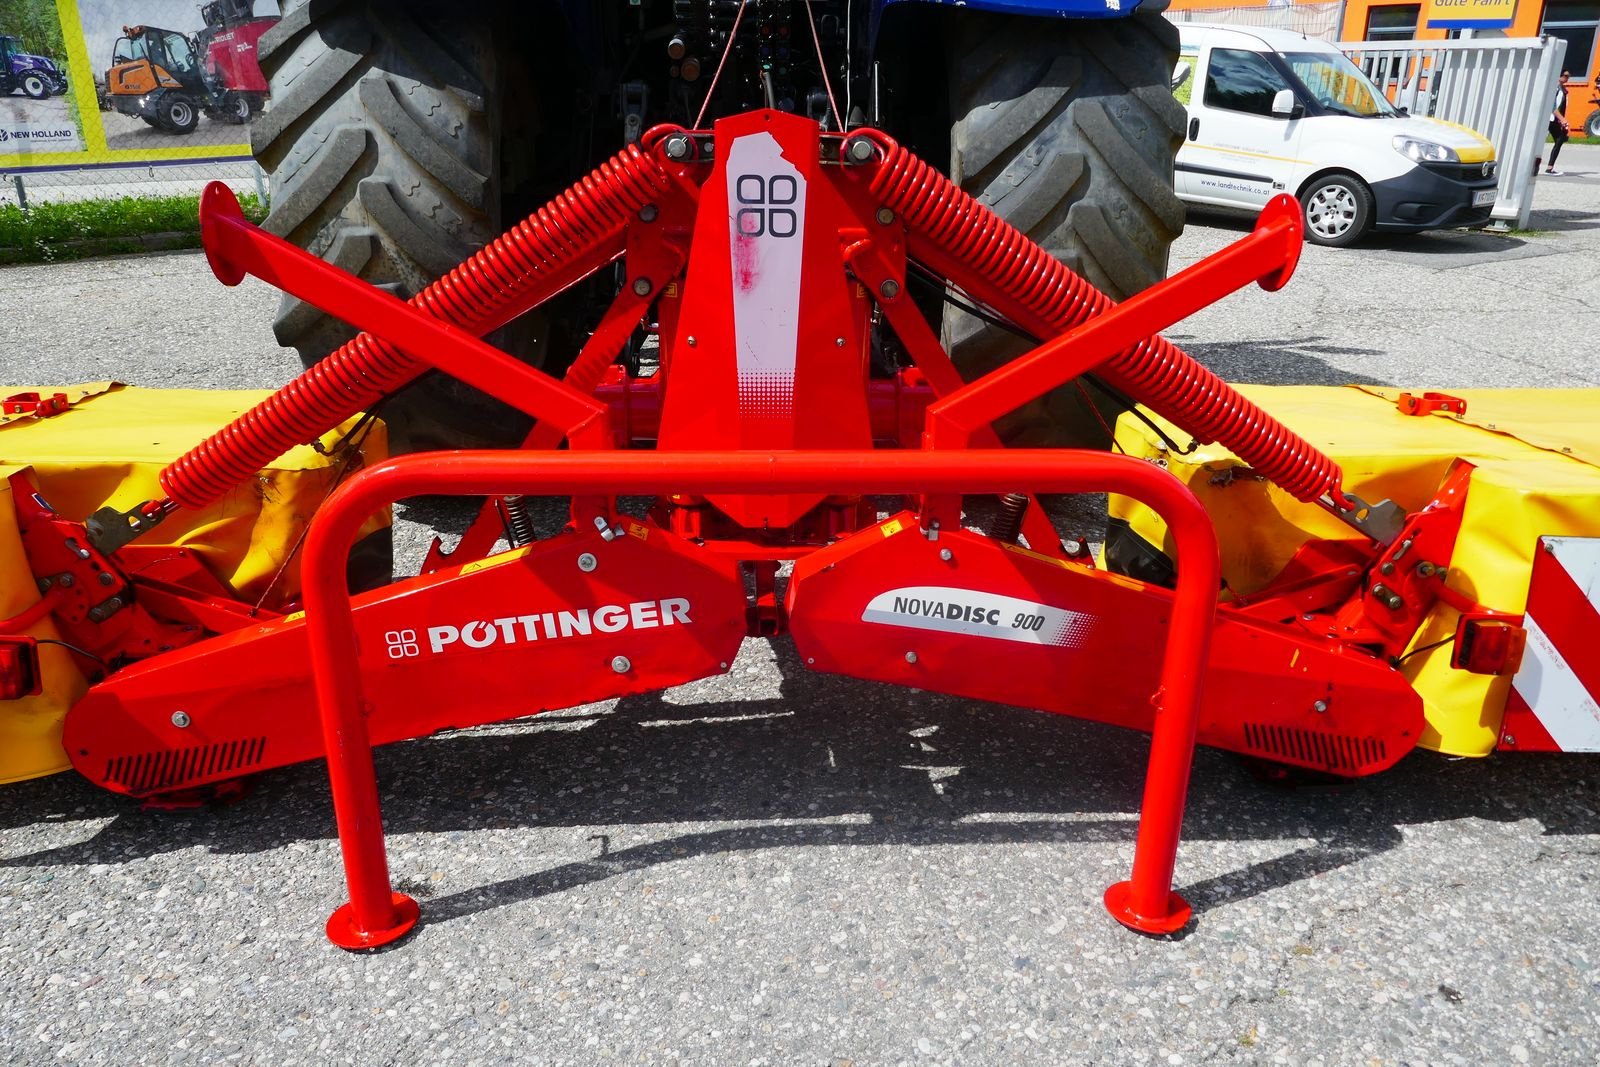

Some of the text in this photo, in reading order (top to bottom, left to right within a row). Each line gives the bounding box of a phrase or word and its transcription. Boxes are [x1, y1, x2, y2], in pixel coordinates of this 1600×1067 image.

[10, 130, 72, 139] NEW HOLLAND
[1201, 180, 1270, 196] www.landtechnik.co.at
[428, 597, 692, 653] PÖTTINGER
[893, 597, 1046, 631] NOVADISC 900
